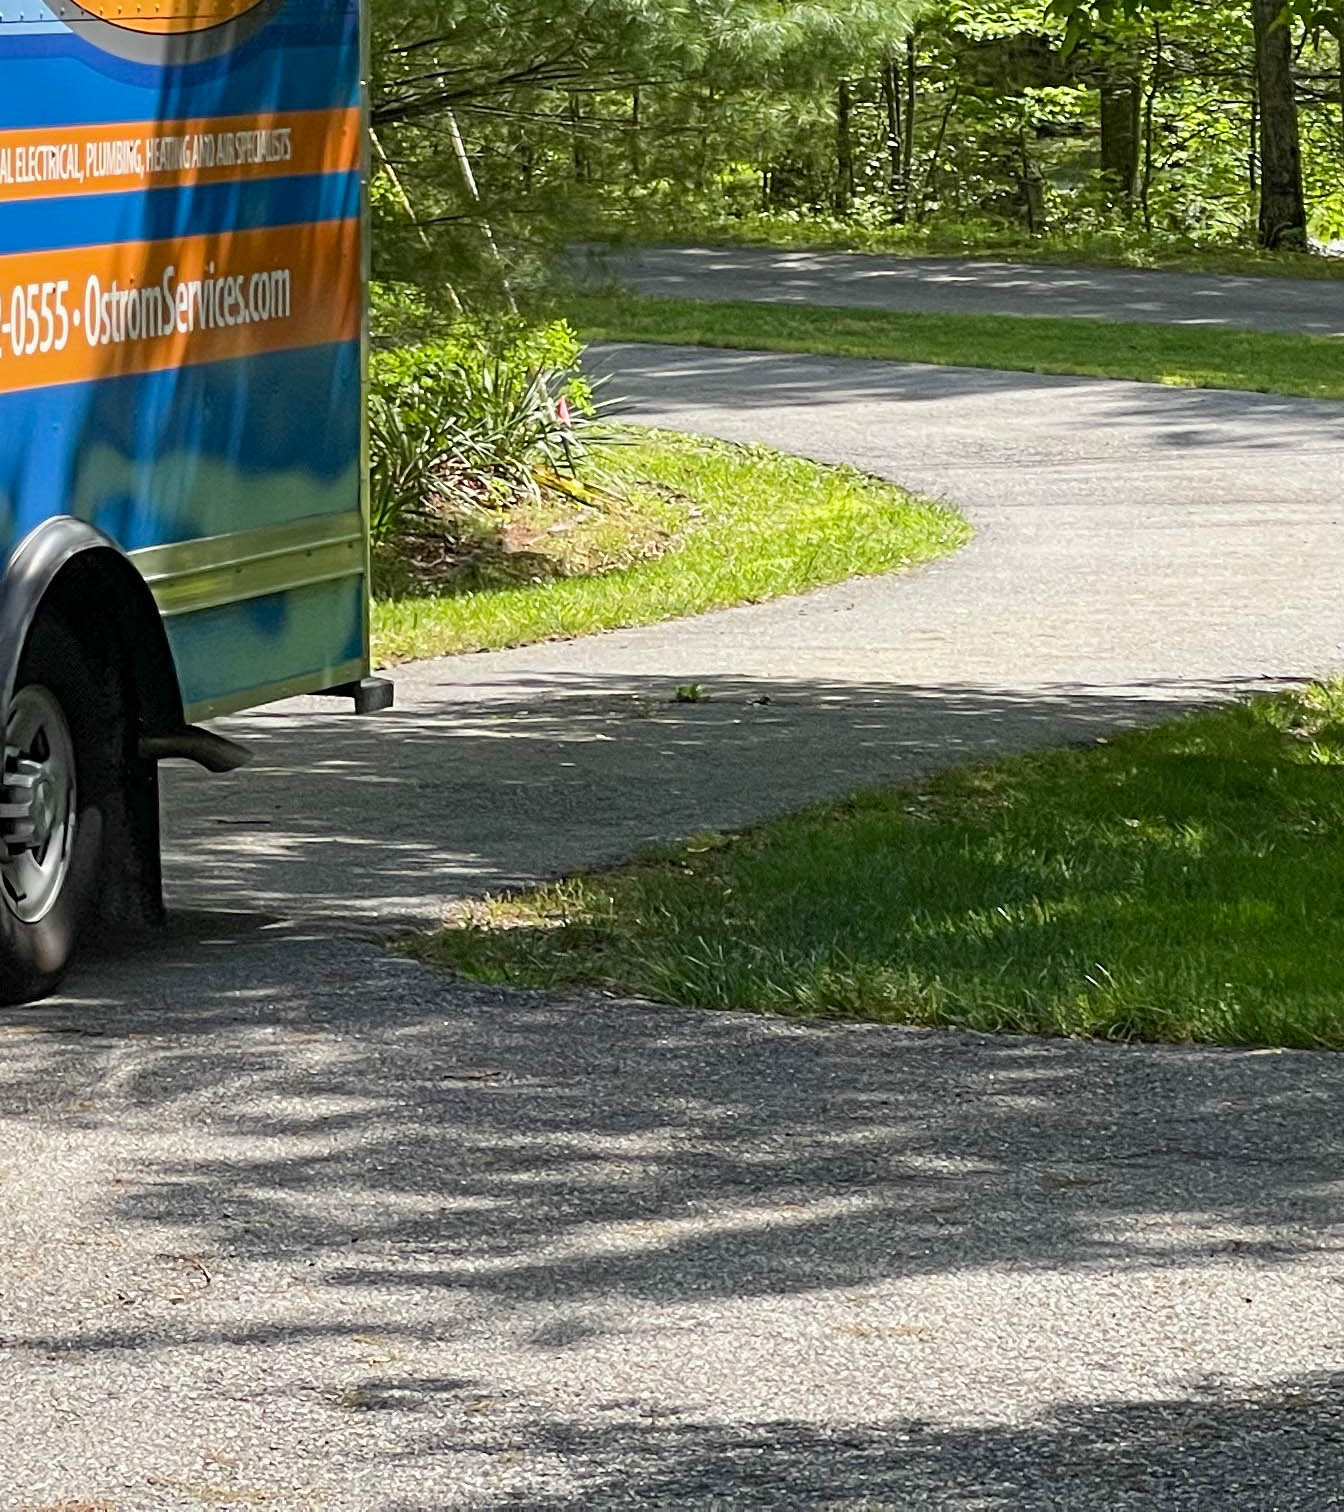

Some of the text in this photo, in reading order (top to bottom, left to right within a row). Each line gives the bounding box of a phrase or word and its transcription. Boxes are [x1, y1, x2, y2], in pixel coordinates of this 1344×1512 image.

[16, 142, 84, 183] ELECTRICAL,
[86, 138, 144, 180] PLUMBING,
[146, 135, 190, 172] HEATING
[191, 133, 216, 168] AND
[216, 132, 236, 166] AIR
[236, 128, 292, 164] SPECIALISTS
[85, 262, 291, 348] OstromServices.com
